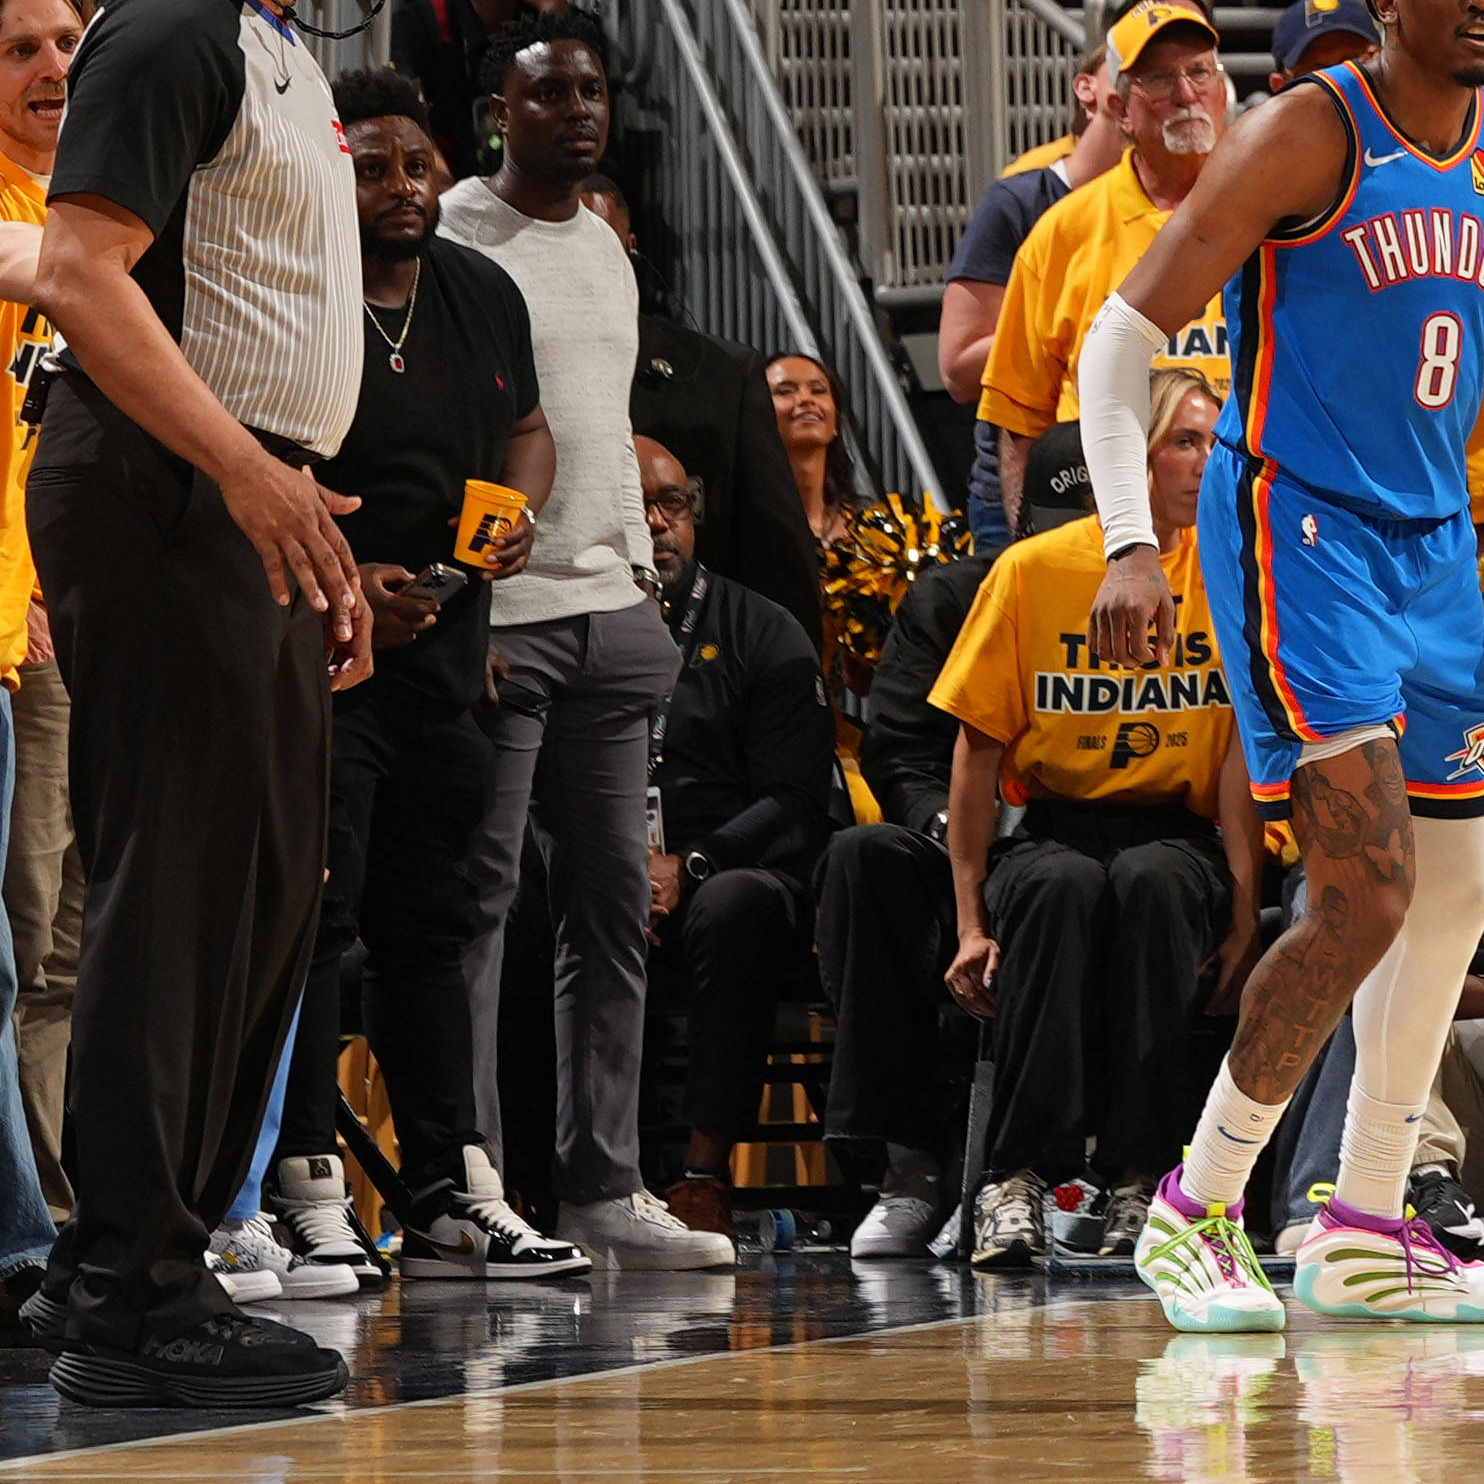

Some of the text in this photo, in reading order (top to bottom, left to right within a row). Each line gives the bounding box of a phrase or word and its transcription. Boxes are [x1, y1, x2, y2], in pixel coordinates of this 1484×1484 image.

[1413, 311, 1462, 410] 8
[1049, 464, 1090, 494] ORIG
[1177, 632, 1212, 665] IS
[1035, 670, 1232, 713] INDIANA
[1076, 731, 1188, 750] FINALS 2025
[143, 1336, 225, 1368] HOKA
